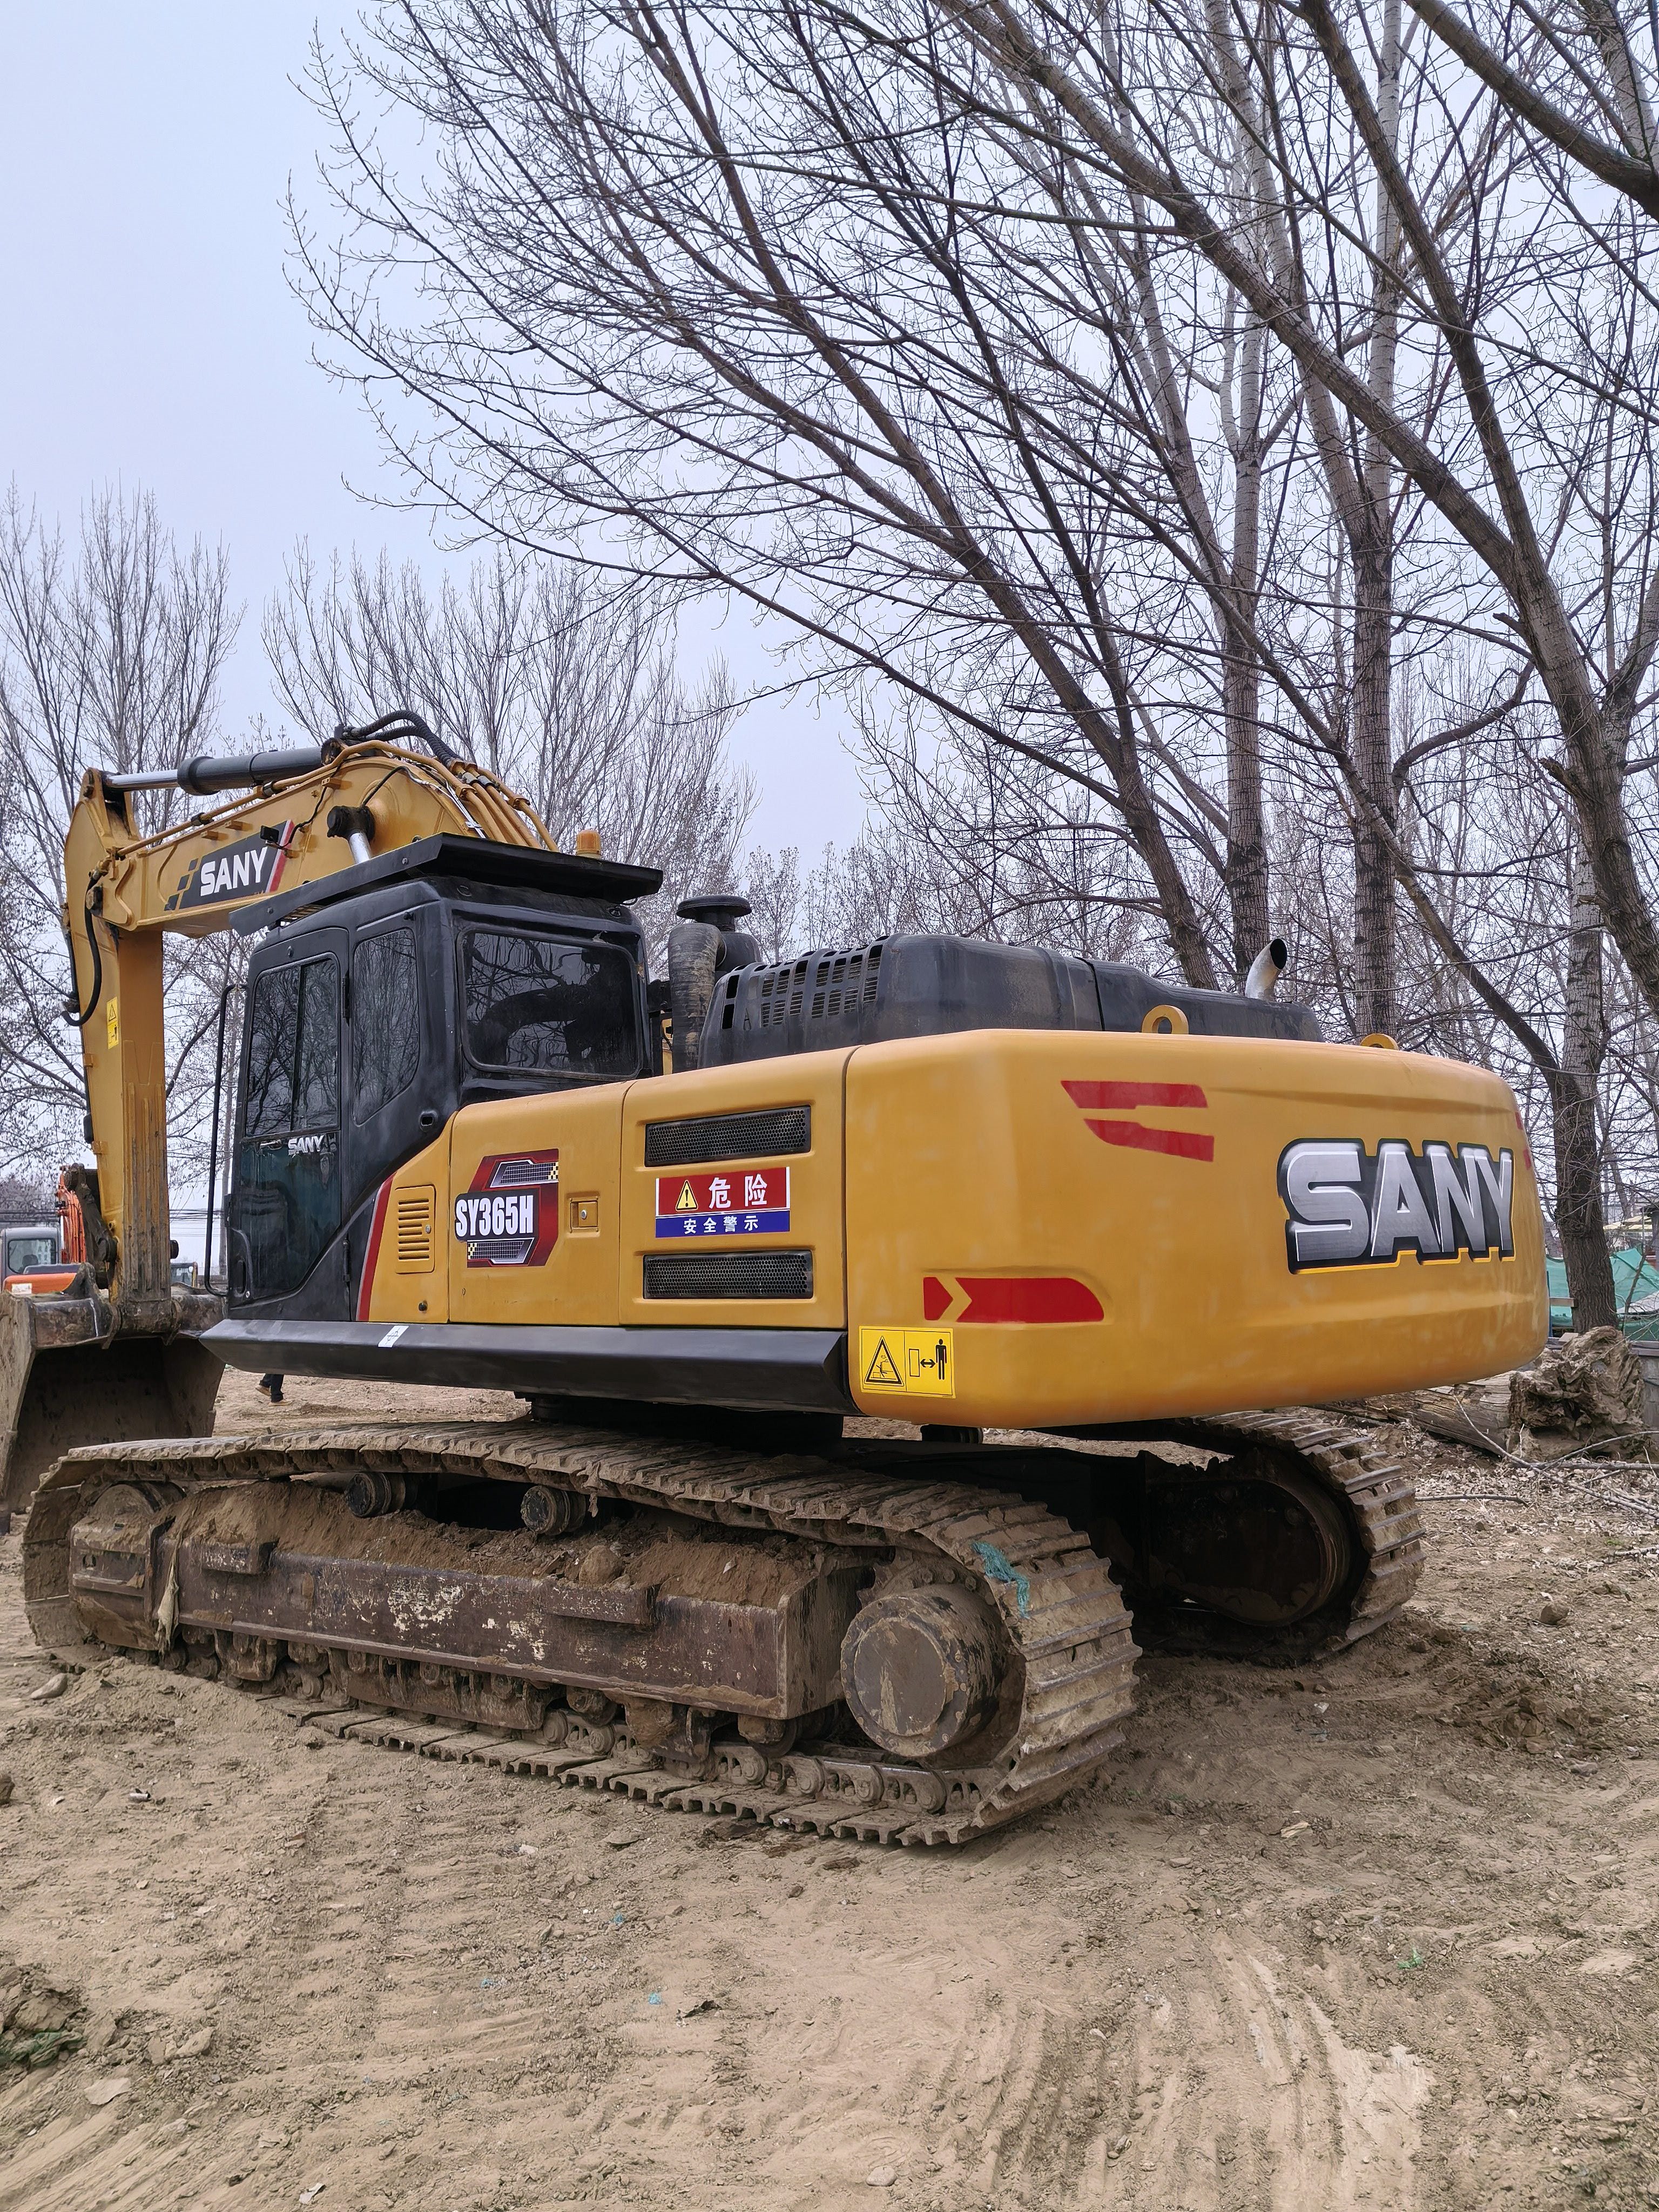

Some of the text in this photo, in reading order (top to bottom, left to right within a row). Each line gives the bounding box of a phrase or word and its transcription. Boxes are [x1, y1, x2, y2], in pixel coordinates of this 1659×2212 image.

[200, 846, 268, 896] SANY
[288, 1135, 324, 1156] SANY
[709, 1174, 767, 1209] 危险
[1285, 1141, 1513, 1264] SANY
[456, 1195, 534, 1237] SY365H
[684, 1216, 758, 1234] 安全警示
